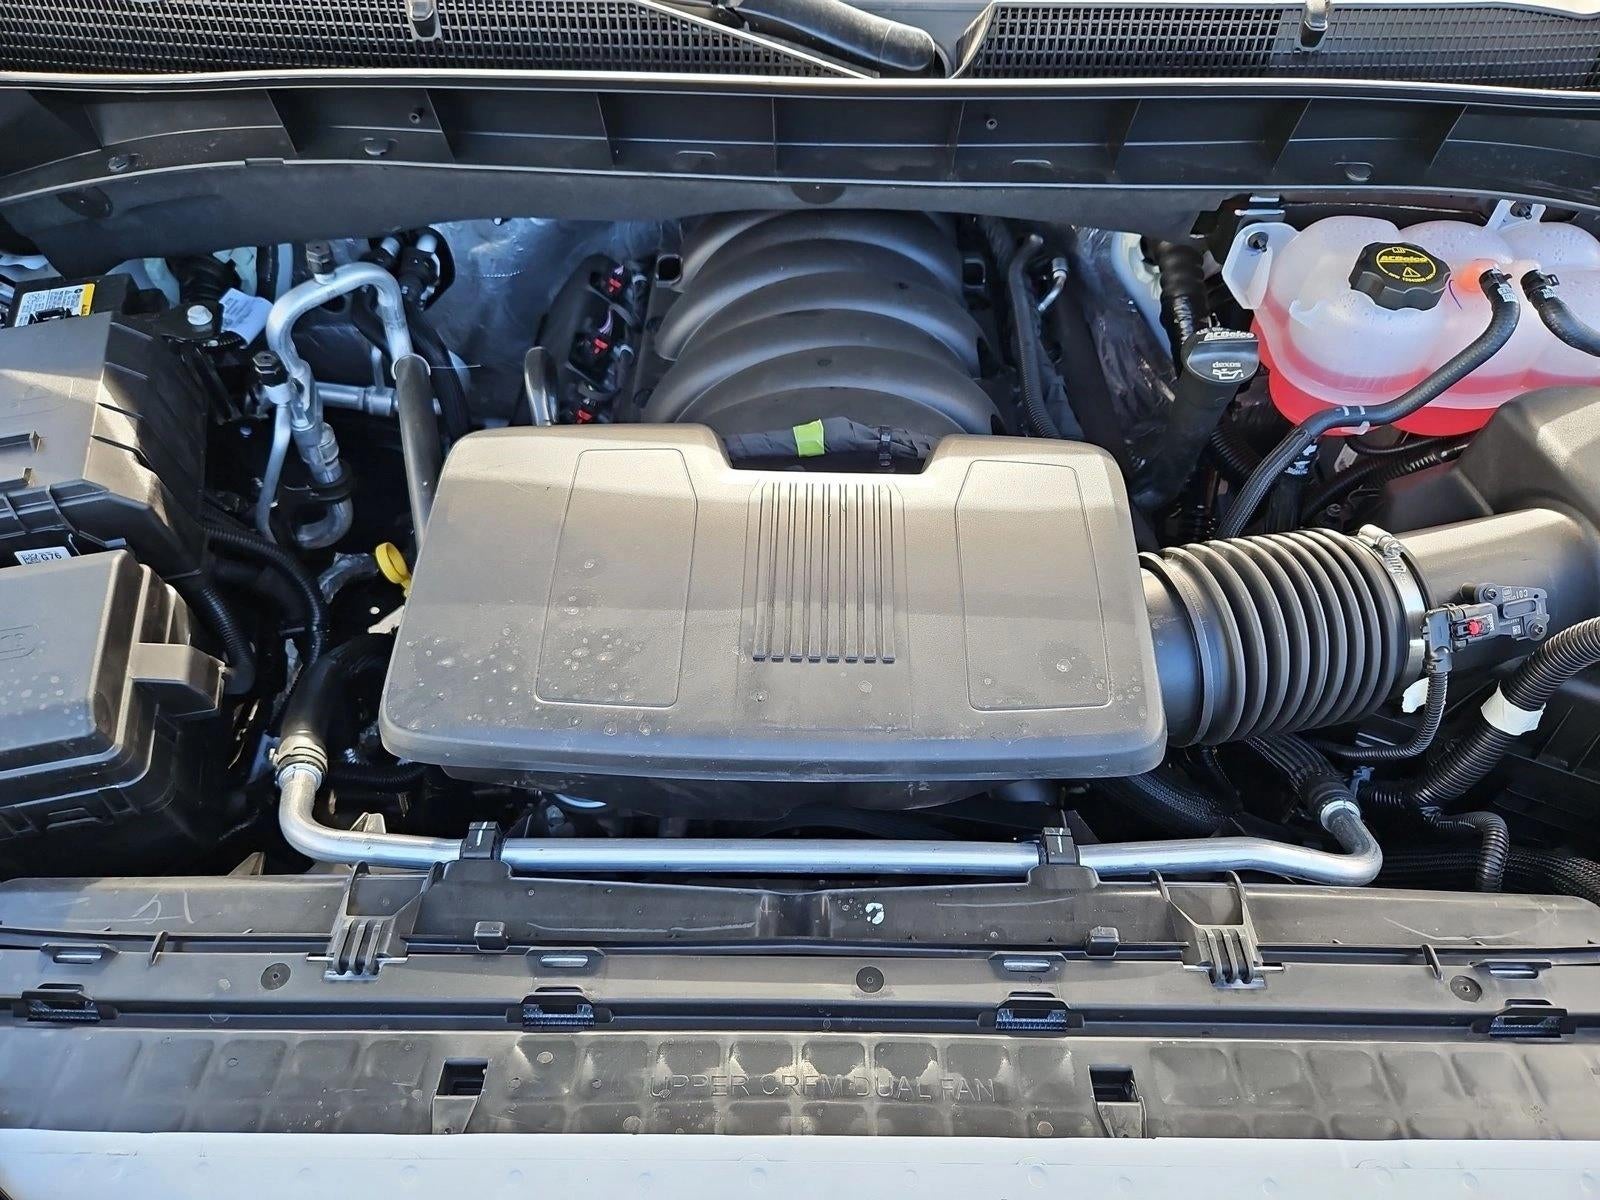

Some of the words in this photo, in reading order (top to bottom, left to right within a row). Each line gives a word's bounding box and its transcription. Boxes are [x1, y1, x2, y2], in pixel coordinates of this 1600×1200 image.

[1379, 255, 1429, 264] ACDelco
[1204, 331, 1255, 341] ACDelco
[1213, 361, 1242, 369] dexos
[41, 552, 62, 561] G76
[650, 1074, 749, 1098] UPPER
[853, 1075, 932, 1100] DUAL
[941, 1076, 996, 1102] FAN
